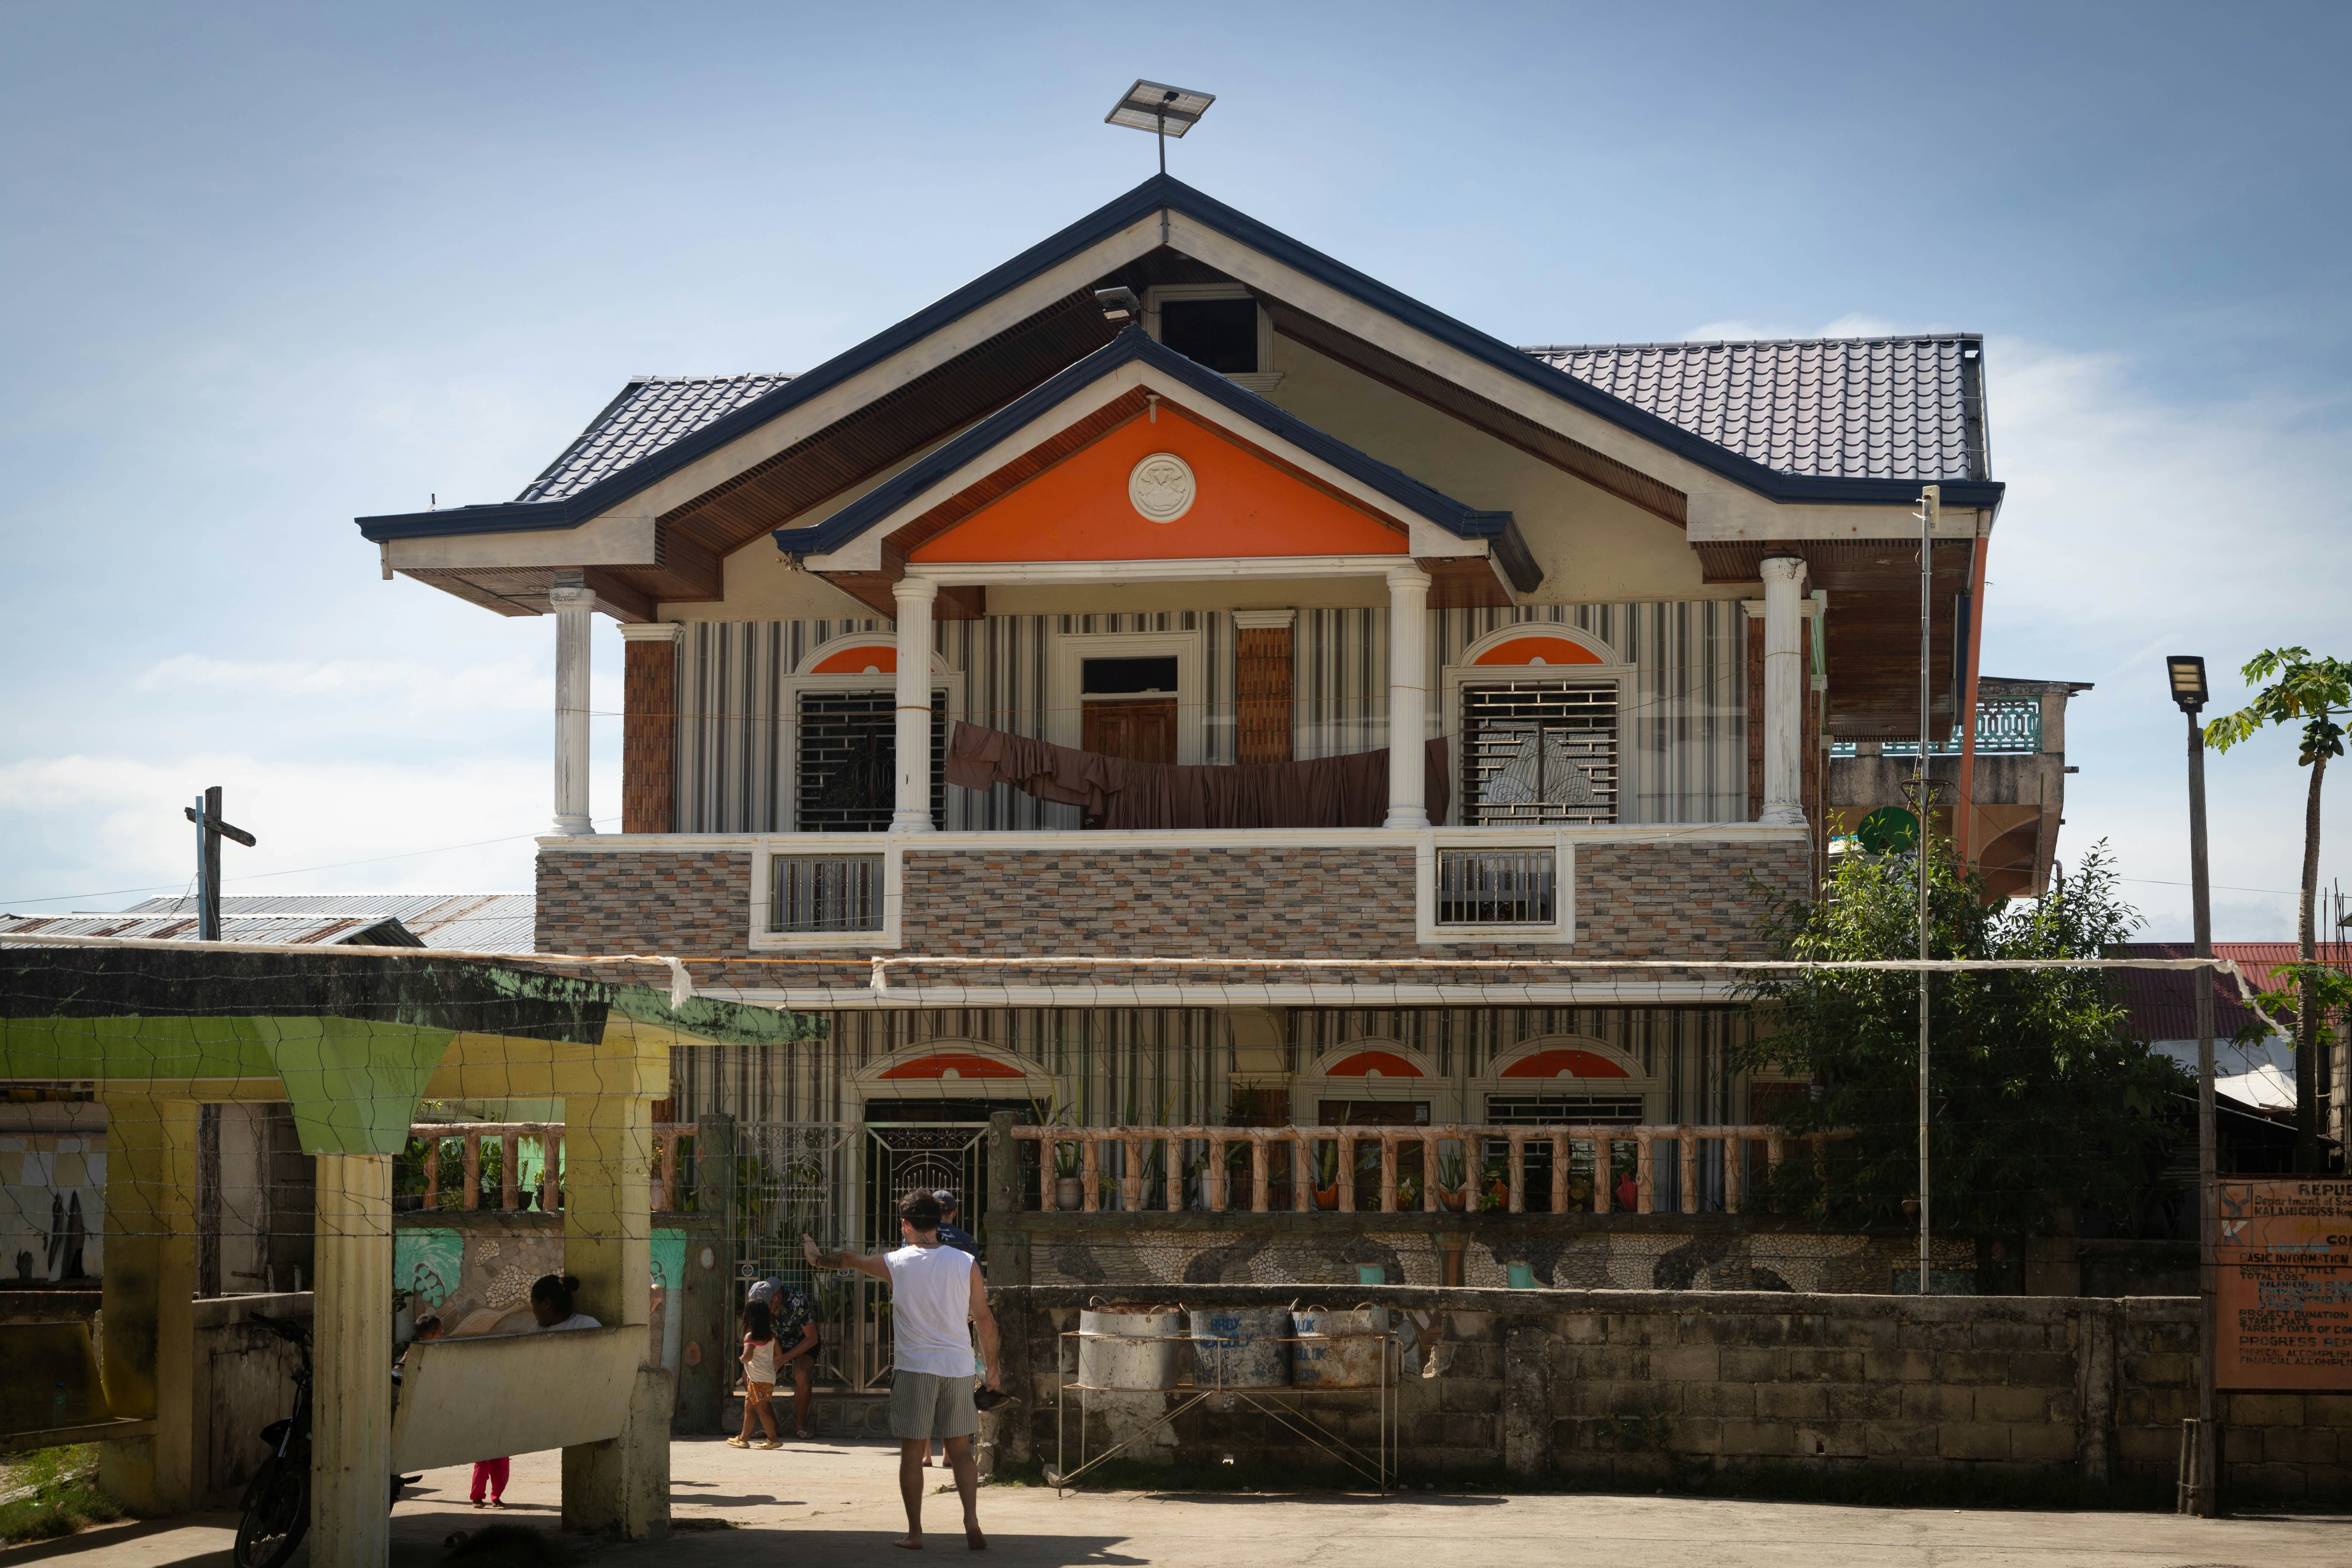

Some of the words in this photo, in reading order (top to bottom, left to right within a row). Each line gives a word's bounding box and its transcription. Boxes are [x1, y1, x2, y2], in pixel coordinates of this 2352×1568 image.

[2255, 1195, 2320, 1207] Department
[2323, 1196, 2332, 1206] of
[2294, 1220, 2352, 1233] Sabana
[2268, 1243, 2330, 1253] LOCATION
[2239, 1253, 2272, 1263] BASIC
[2303, 1266, 2337, 1274] TITLE
[2259, 1302, 2304, 1311] OTHERS
[2239, 1317, 2276, 1325] START
[2239, 1336, 2317, 1347] PROGRESS
[2239, 1357, 2292, 1365] FINANCIAL
